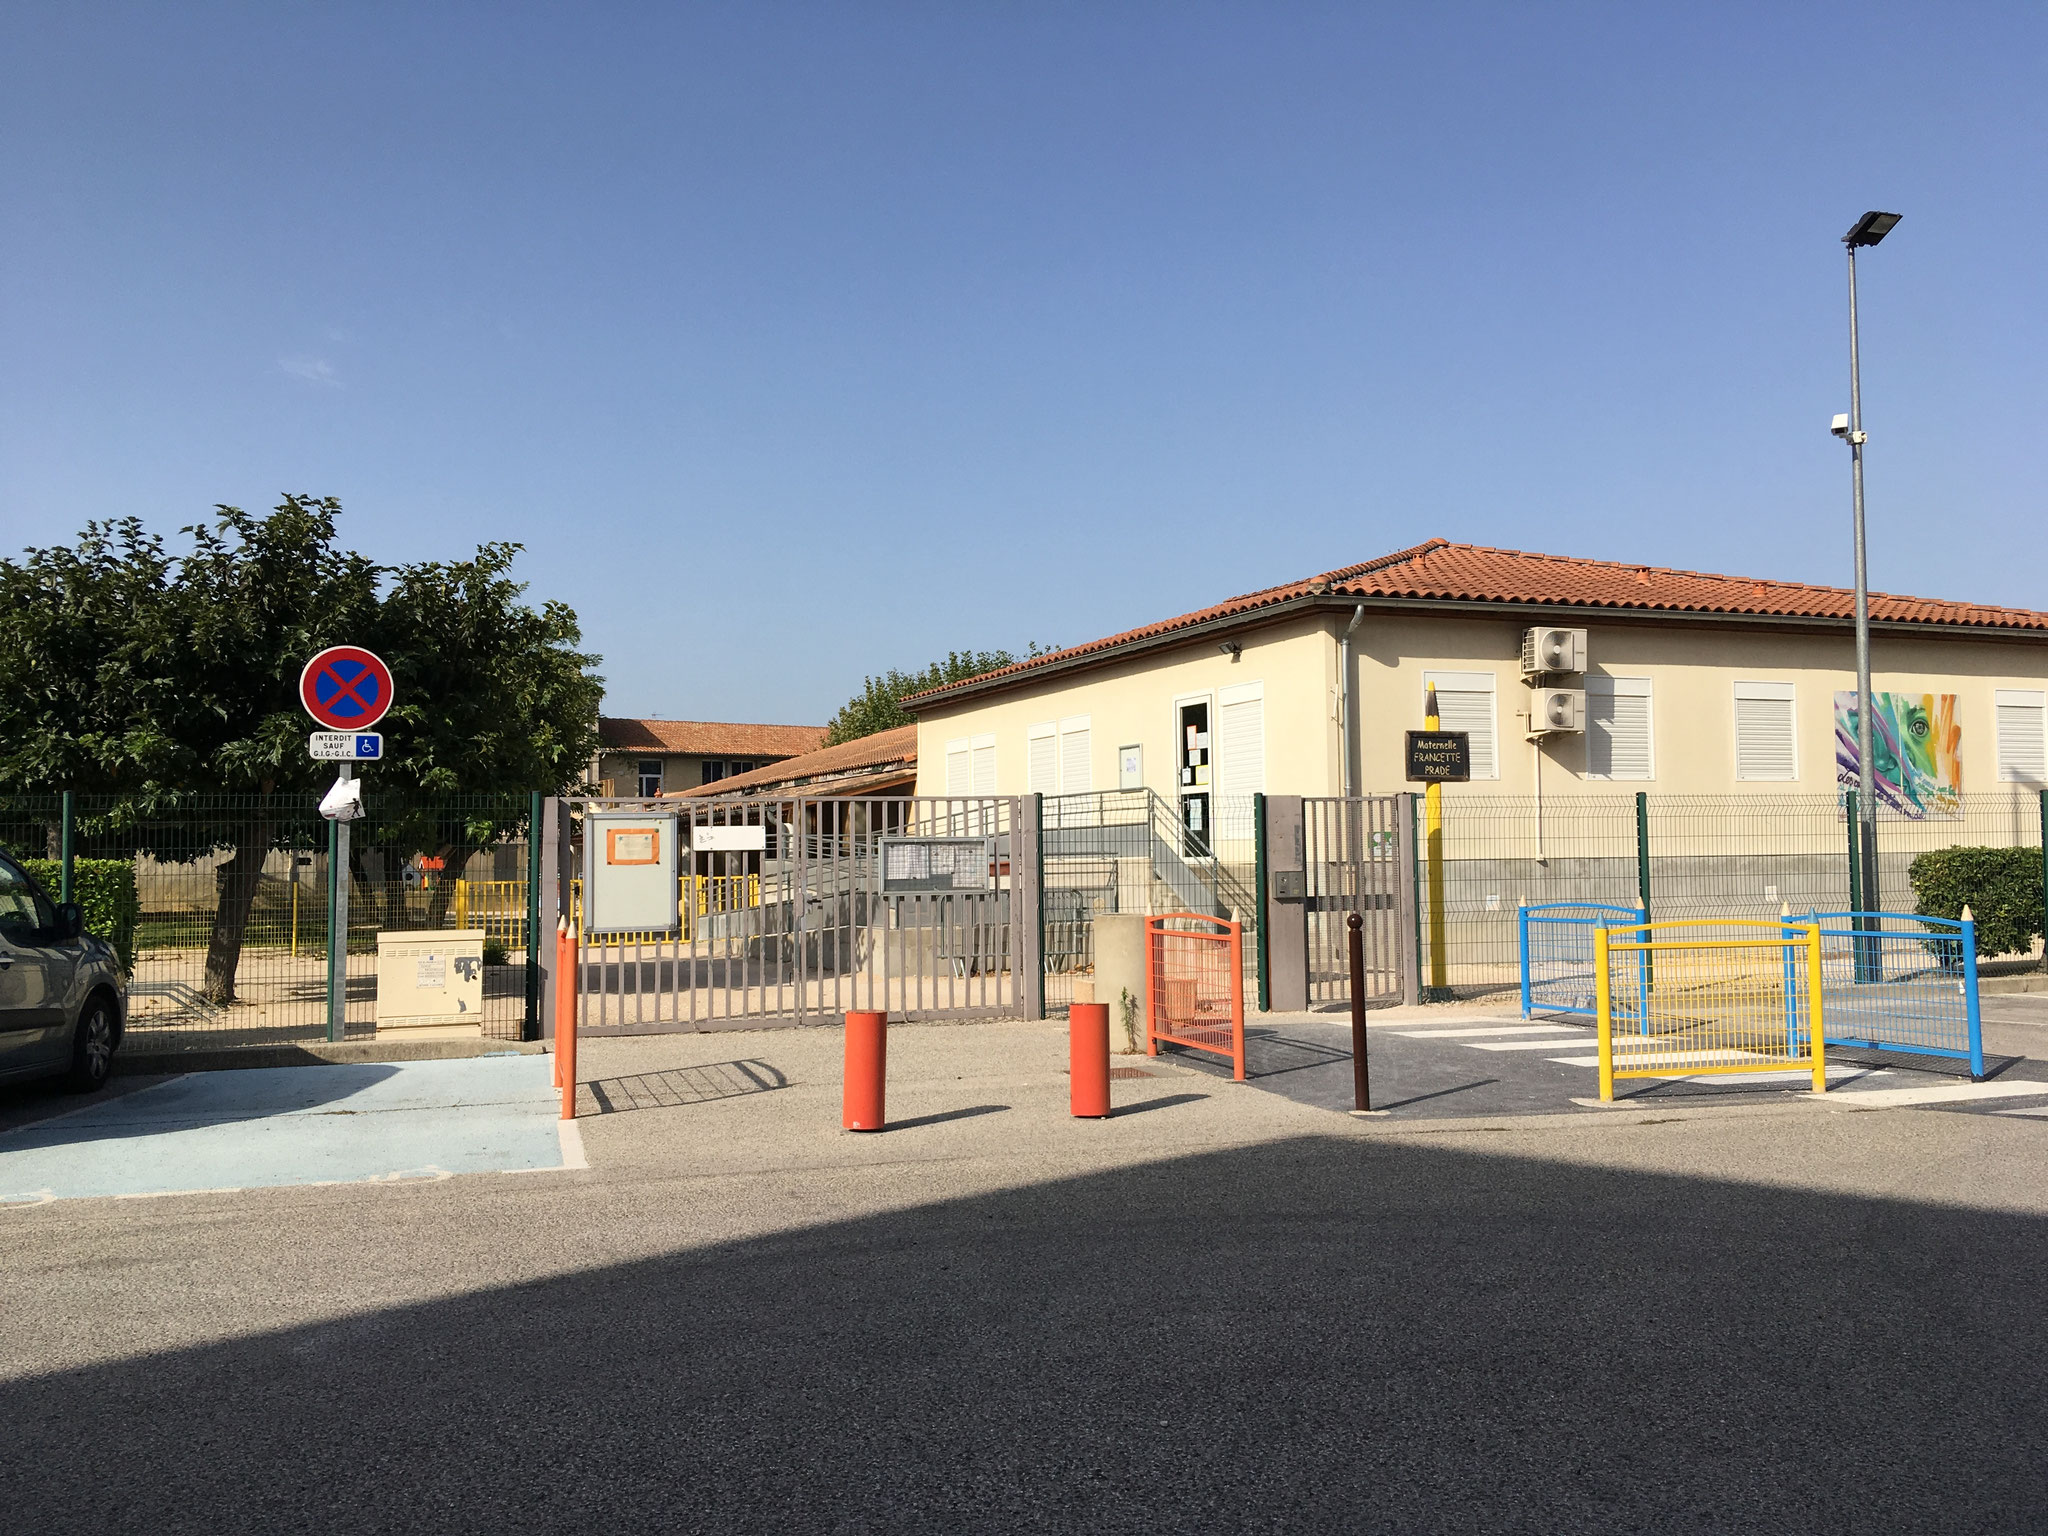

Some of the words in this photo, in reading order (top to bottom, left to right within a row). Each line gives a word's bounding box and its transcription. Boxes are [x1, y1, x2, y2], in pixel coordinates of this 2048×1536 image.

[1417, 739, 1457, 750] Maternelle
[1414, 752, 1461, 763] FRANCETTE
[1424, 765, 1451, 776] PRADE
